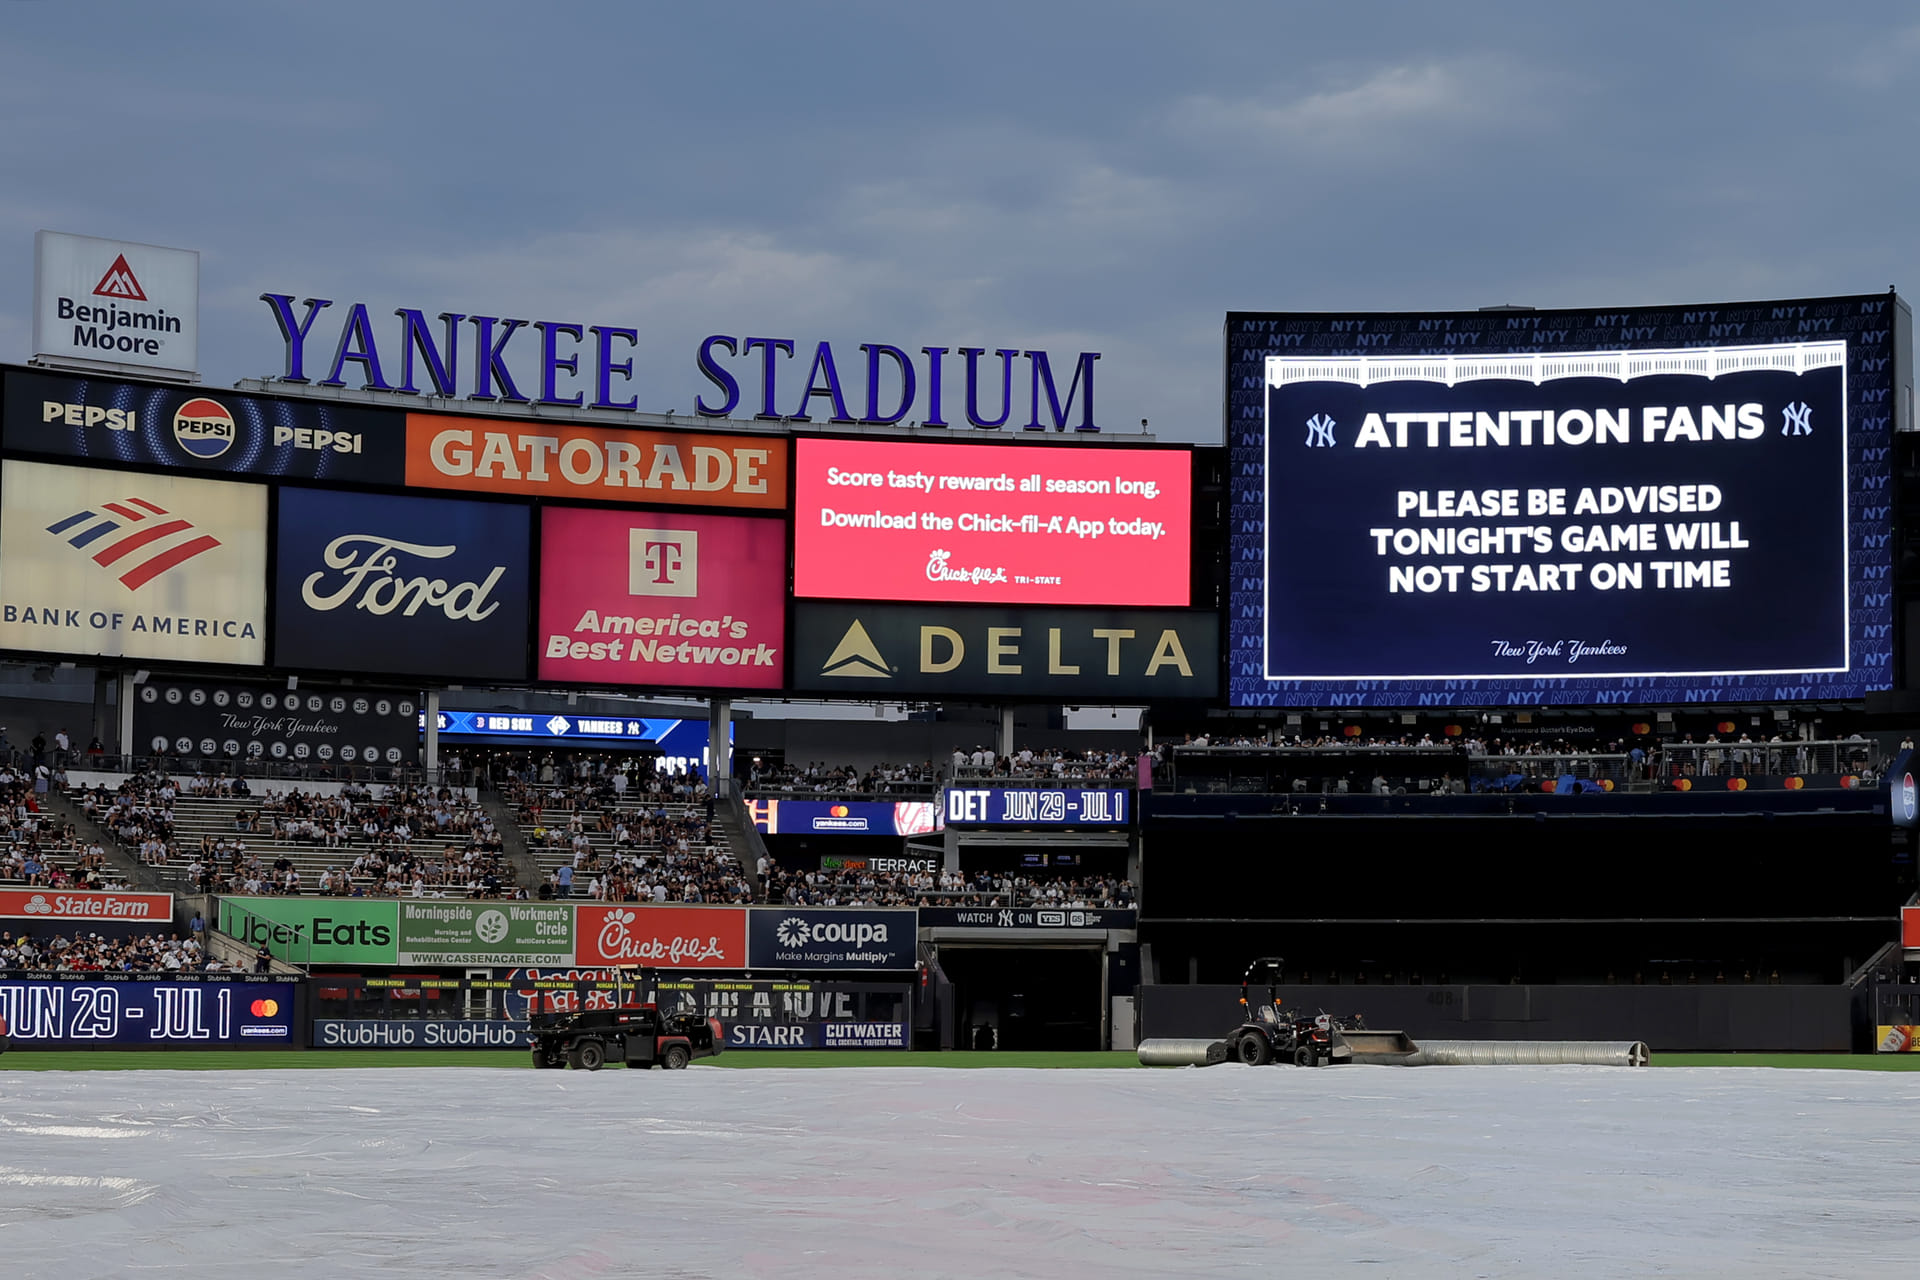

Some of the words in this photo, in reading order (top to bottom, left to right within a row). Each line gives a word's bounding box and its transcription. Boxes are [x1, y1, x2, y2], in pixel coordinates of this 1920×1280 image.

[57, 297, 181, 333] Benjamin
[1242, 320, 1279, 331] NYY
[1594, 315, 1630, 326] NYY
[73, 325, 160, 356] Moore
[260, 293, 638, 410] YANKEE
[695, 335, 1101, 433] STADIUM
[42, 400, 136, 431] PEPSI
[1354, 408, 1630, 448] ATTENTION
[1642, 403, 1765, 442] FANS
[177, 419, 232, 437] PEPSI
[273, 425, 362, 454] PEPSI
[430, 429, 769, 495] GATORADE
[827, 467, 883, 487] Score
[887, 470, 935, 494] tasty
[939, 473, 1015, 492] rewards
[1019, 474, 1041, 492] all
[1045, 478, 1110, 494] season
[1115, 476, 1160, 499] long.
[1397, 489, 1520, 518] PLEASE
[1527, 488, 1566, 516] BE
[1573, 484, 1722, 515] ADVISED
[821, 508, 917, 529] Download
[921, 512, 954, 531] the
[1065, 516, 1104, 539] App
[1108, 517, 1166, 540] today.
[1370, 525, 1553, 555] TONIGHT'S
[1561, 523, 1657, 553] GAME
[1664, 521, 1749, 550] WILL
[302, 534, 506, 622] Ford
[1014, 575, 1061, 585] TRI-STATE
[1389, 565, 1465, 593] NOT
[1471, 563, 1583, 592] START
[1590, 562, 1642, 590] ON
[1650, 560, 1731, 589] TIME
[4, 605, 80, 627] BANK
[89, 612, 123, 631] OF
[132, 615, 256, 640] AMERICA
[574, 609, 748, 639] America's
[545, 635, 624, 662] Best
[629, 640, 776, 666] Network
[919, 625, 1194, 677] DELTA
[1491, 640, 1525, 657] New
[1526, 640, 1564, 664] York
[1568, 639, 1628, 664] Yankees
[146, 690, 152, 698] 4
[171, 691, 177, 700] 3
[194, 693, 201, 701] 5
[218, 693, 225, 702] 7
[240, 695, 250, 704] 37
[266, 697, 272, 706] 8
[289, 698, 295, 707] 8
[310, 699, 320, 708] 16
[333, 701, 343, 710] 15
[356, 702, 366, 711] 32
[380, 703, 386, 712] 9
[401, 704, 411, 713] 10
[1241, 694, 1278, 706] NYY
[1596, 692, 1632, 703] NYY
[220, 713, 250, 729] New
[251, 716, 283, 737] York
[287, 717, 338, 738] Yankees
[489, 717, 510, 730] RED
[511, 718, 533, 731] SOX
[577, 719, 623, 734] YANKEES
[158, 740, 162, 749] 1
[178, 740, 190, 750] 44
[202, 741, 214, 751] 23
[225, 742, 237, 752] 49
[249, 744, 261, 753] 42
[276, 745, 282, 754] 6
[297, 745, 307, 755] 51
[319, 747, 331, 757] 46
[342, 749, 354, 758] 20
[368, 750, 374, 759] 2
[389, 751, 398, 760] 21
[950, 790, 990, 821] DET
[1003, 791, 1037, 821] JUN
[1040, 792, 1065, 821] 29
[1079, 792, 1112, 821] JUL
[1114, 792, 1123, 821] 1
[815, 819, 865, 828] yankees.com
[869, 858, 936, 873] TERRACE
[405, 905, 473, 923] Morningside
[510, 906, 569, 921] Workmen's
[957, 913, 993, 923] WATCH
[1018, 913, 1032, 924] ON
[1041, 914, 1061, 922] YES
[312, 918, 391, 946] Eats
[434, 929, 459, 937] Nursing
[536, 922, 568, 936] Circle
[597, 909, 725, 963] Chick-fil-A
[812, 921, 889, 948] coupa
[412, 954, 561, 964] WWW.CASSENACARE.COM
[776, 951, 803, 961] Make
[804, 951, 844, 963] Margins
[59, 973, 85, 981] StubHub
[175, 974, 200, 982] StubHub
[245, 975, 268, 983] StubHub
[275, 975, 299, 983] StubHub
[70, 987, 119, 1038] 29
[150, 988, 210, 1039] JUL
[218, 988, 230, 1039] 1
[323, 1024, 415, 1044] StubHub
[424, 1023, 515, 1044] StubHub
[732, 1025, 804, 1045] STARR
[826, 1024, 902, 1038] CUTWATER
